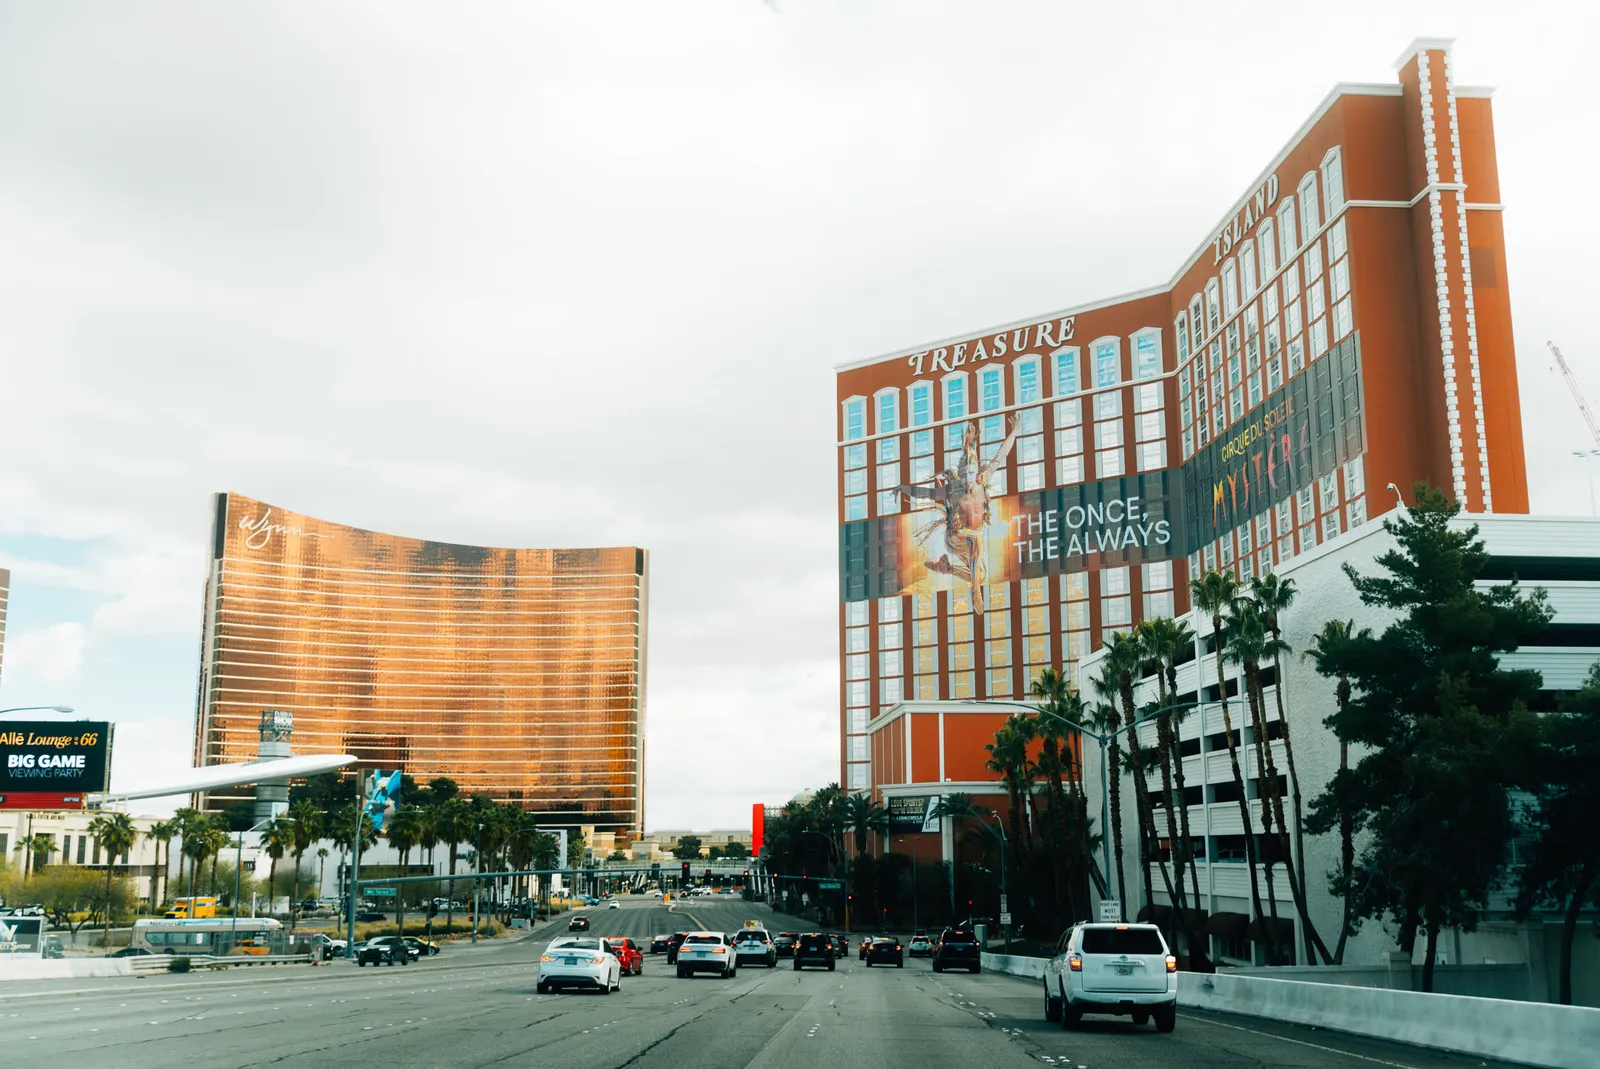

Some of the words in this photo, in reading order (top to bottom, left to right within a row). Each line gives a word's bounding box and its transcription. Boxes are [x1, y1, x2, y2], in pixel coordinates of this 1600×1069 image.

[1213, 173, 1280, 267] ISLAND
[908, 316, 1076, 376] TREASURE
[1221, 428, 1250, 462] CIRQUE
[1250, 420, 1264, 442] DU
[1264, 395, 1295, 432] SOLEIL
[238, 507, 334, 550] Wynn
[1012, 509, 1058, 537] THE
[1065, 496, 1149, 529] ONCE,
[1012, 536, 1059, 564] THE
[1066, 520, 1171, 558] ALWAYS
[0, 732, 24, 745] Allē
[26, 732, 72, 749] Lounge
[80, 732, 99, 746] 66
[8, 754, 35, 768] BIG
[38, 754, 86, 768] GAME
[8, 768, 52, 778] VIEWING
[54, 769, 84, 778] PARTY
